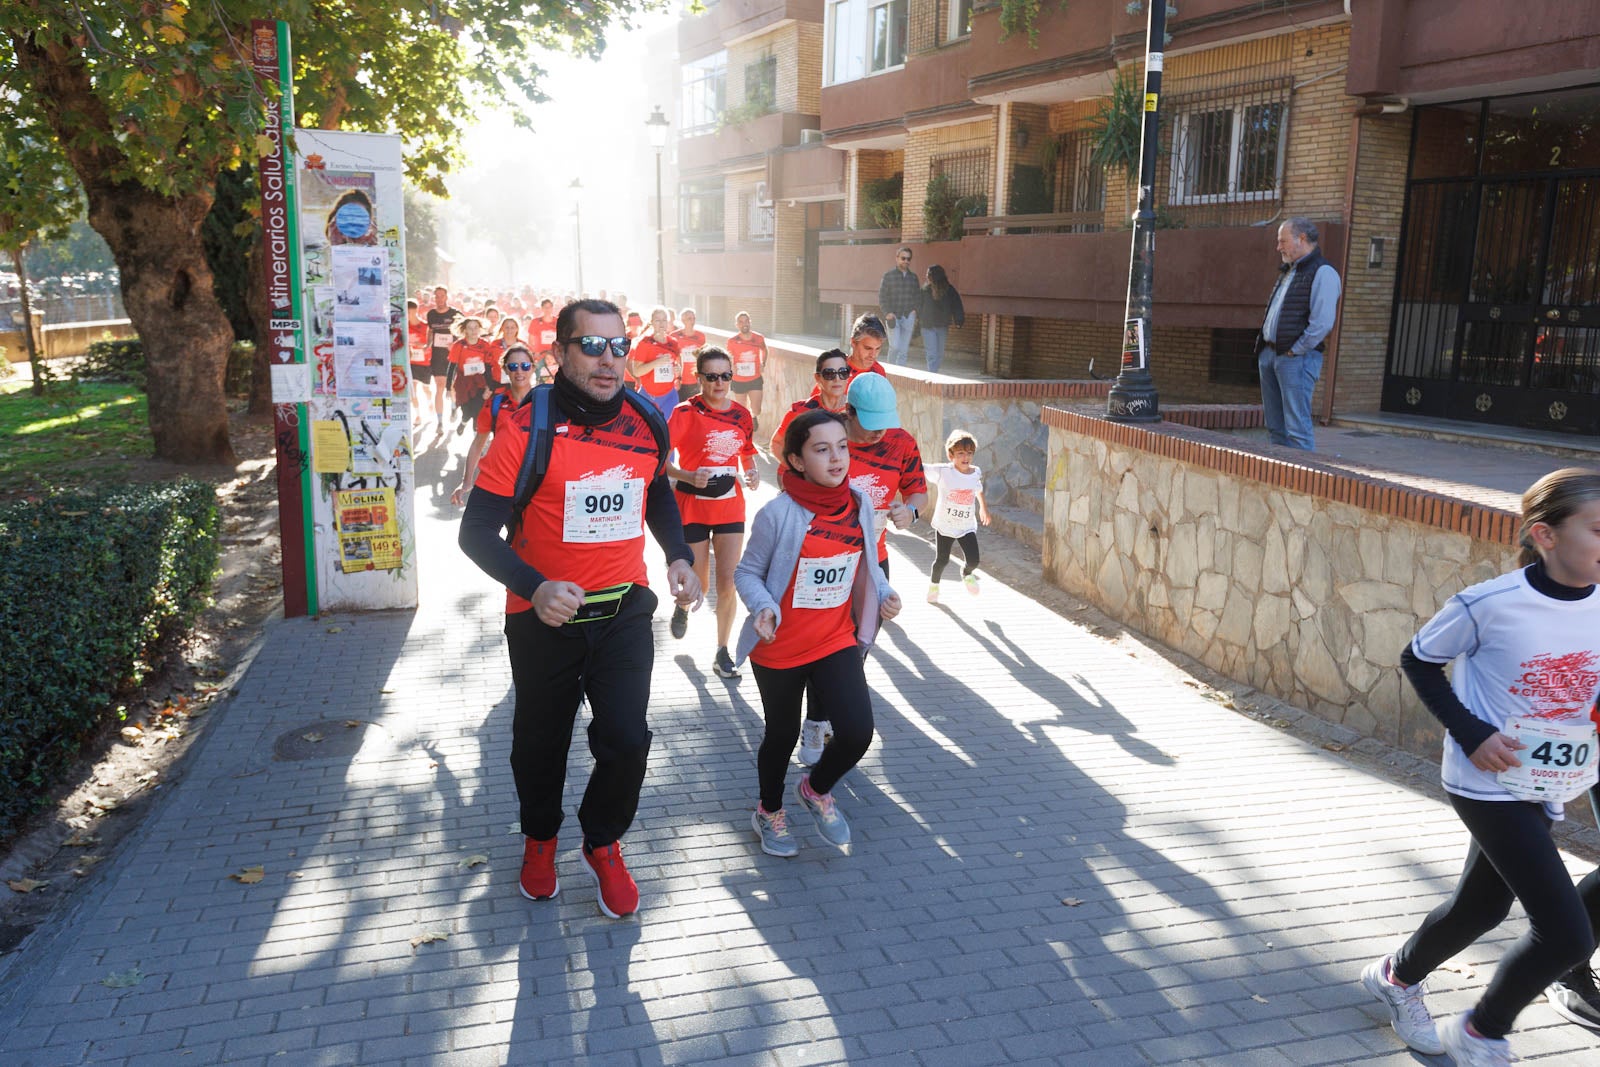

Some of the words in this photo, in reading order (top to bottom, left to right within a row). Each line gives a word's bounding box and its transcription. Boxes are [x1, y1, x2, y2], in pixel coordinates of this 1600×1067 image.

[1549, 146, 1561, 166] 2
[272, 321, 300, 329] MPS
[341, 493, 385, 504] MOLINA
[585, 493, 624, 514] 909
[947, 507, 970, 519] 1383
[372, 541, 389, 552] 149
[392, 540, 400, 550] €
[814, 566, 847, 585] 907
[1522, 672, 1599, 688] carrera
[1531, 741, 1589, 767] 430
[1530, 768, 1559, 779] SUDOR
[1560, 770, 1567, 779] Y
